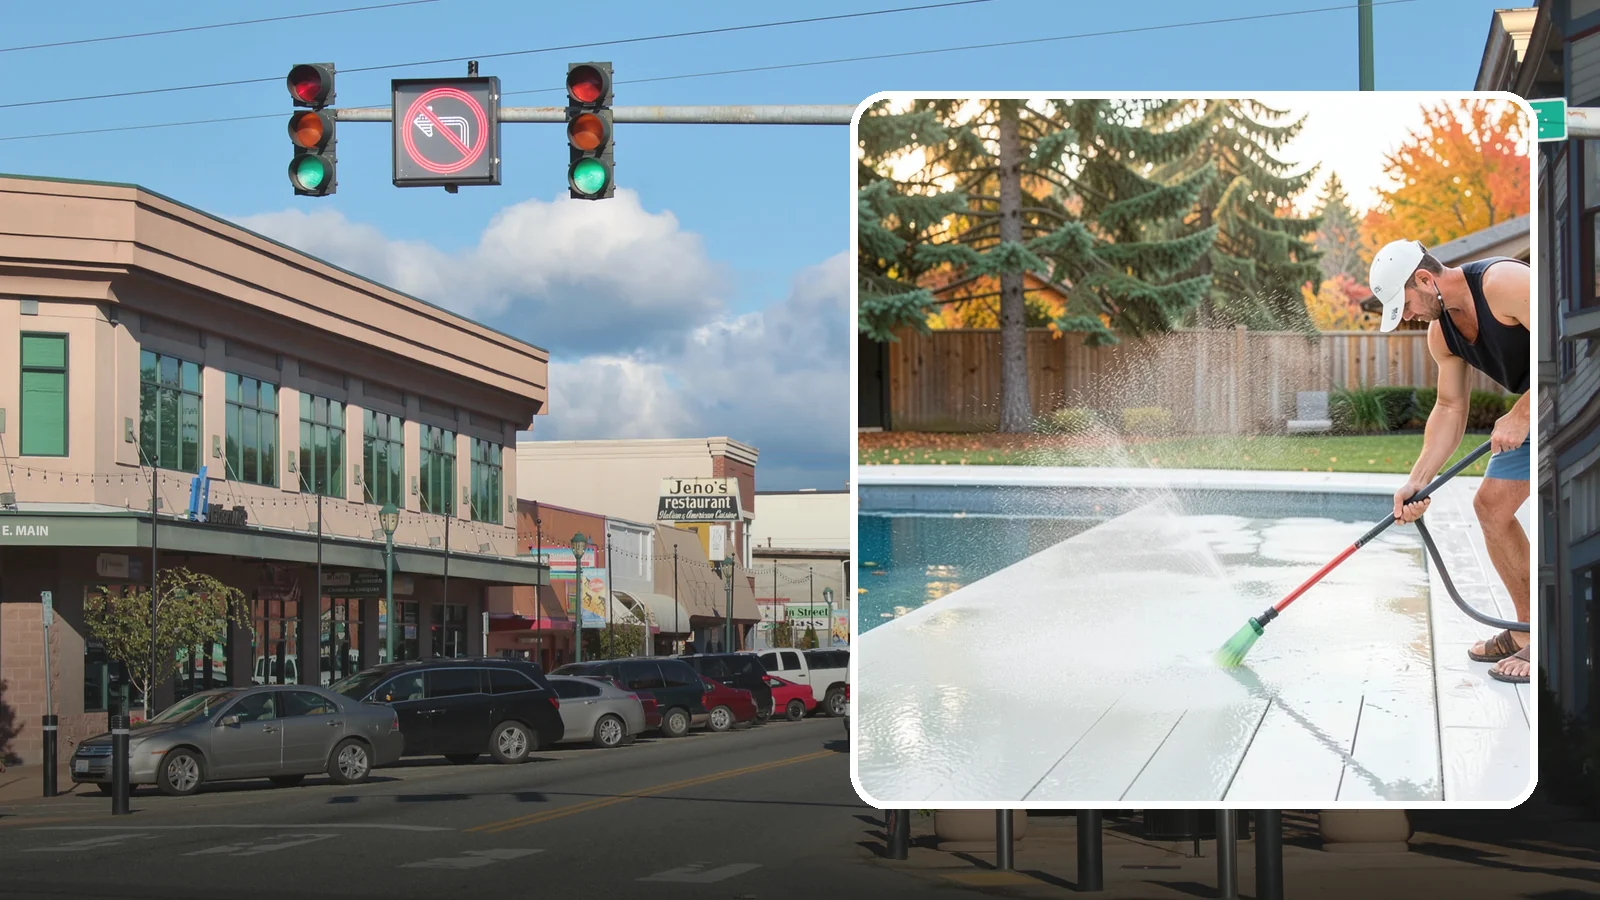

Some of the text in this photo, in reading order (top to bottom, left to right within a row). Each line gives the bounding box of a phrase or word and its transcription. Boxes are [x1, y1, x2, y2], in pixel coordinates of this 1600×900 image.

[670, 480, 728, 494] Jeno's
[665, 496, 731, 509] restaurant
[658, 509, 681, 520] Italian
[686, 509, 714, 519] American
[715, 509, 738, 519] Cuisine
[2, 525, 49, 536] E. MAIN
[797, 607, 829, 617] Street
